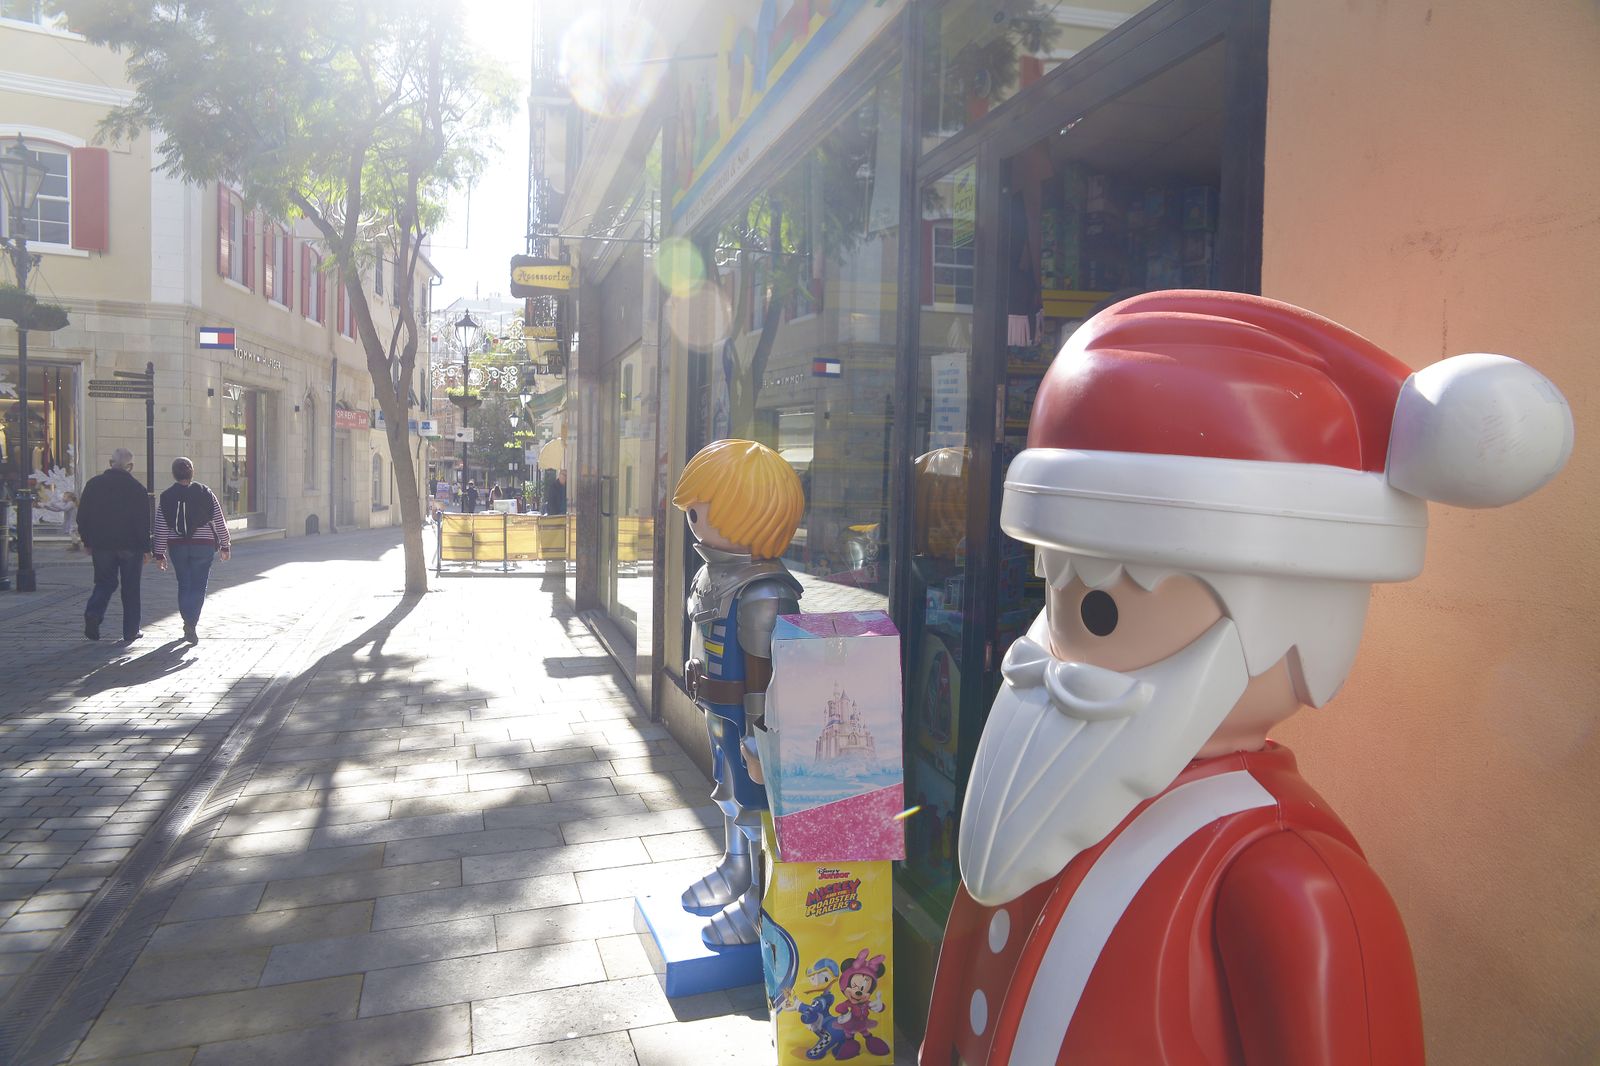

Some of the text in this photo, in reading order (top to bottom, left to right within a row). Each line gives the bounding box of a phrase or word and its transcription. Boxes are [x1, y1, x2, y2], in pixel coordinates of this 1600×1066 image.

[235, 348, 257, 361] TOMMY
[806, 878, 861, 907] MICKEY
[806, 893, 858, 917] ROADSTER
